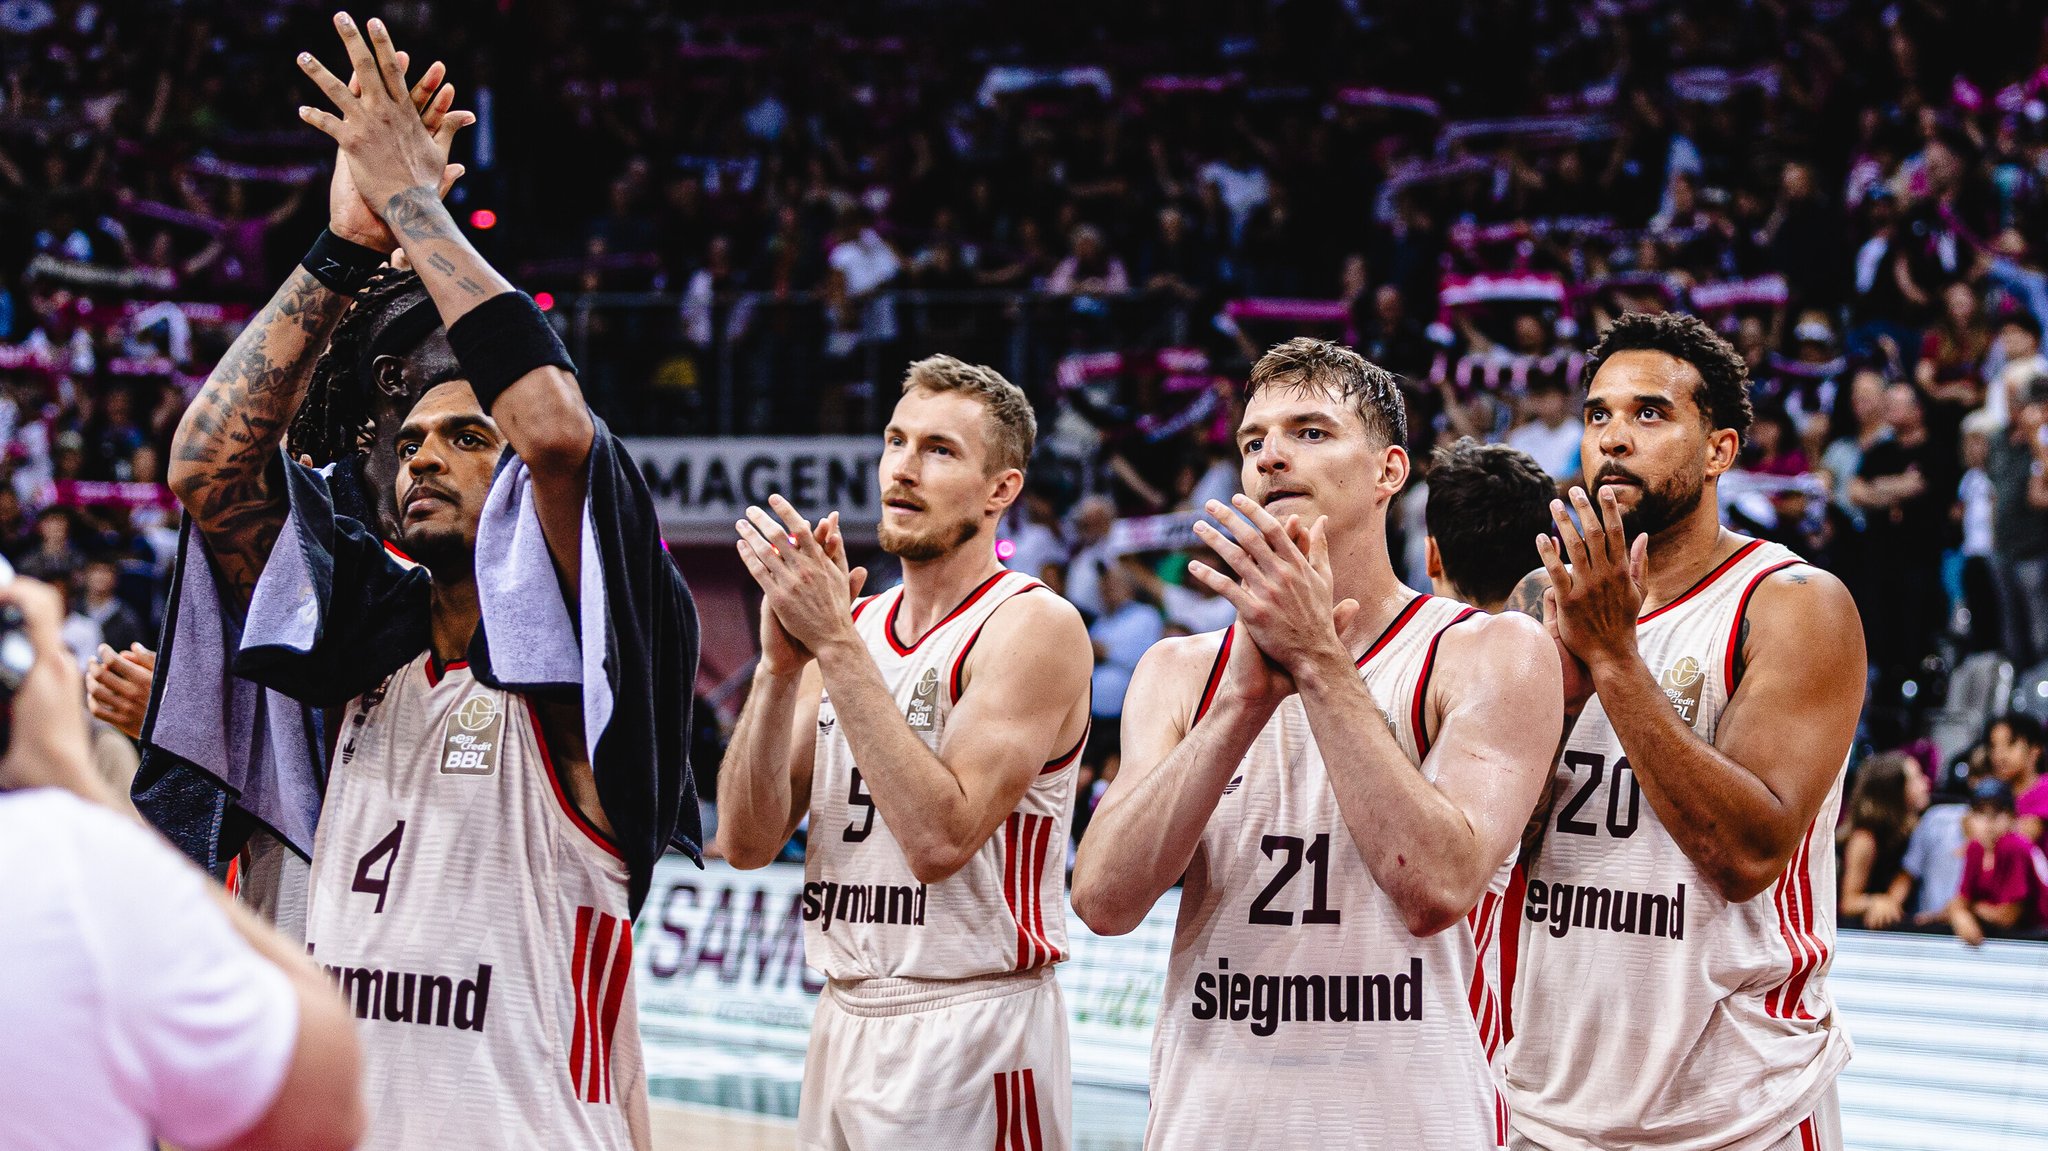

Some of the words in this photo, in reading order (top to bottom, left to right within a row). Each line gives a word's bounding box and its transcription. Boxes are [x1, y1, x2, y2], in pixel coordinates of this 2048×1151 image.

[640, 454, 881, 507] MAGEN
[461, 741, 492, 751] Credit
[908, 712, 931, 726] BBL
[445, 751, 489, 769] BBL
[1556, 750, 1640, 839] 20
[843, 767, 876, 843] 5
[351, 820, 406, 914] 4
[1248, 833, 1341, 926] 21
[1525, 879, 1686, 941] egmund
[306, 942, 493, 1033] mund
[1191, 957, 1423, 1037] siegmund
